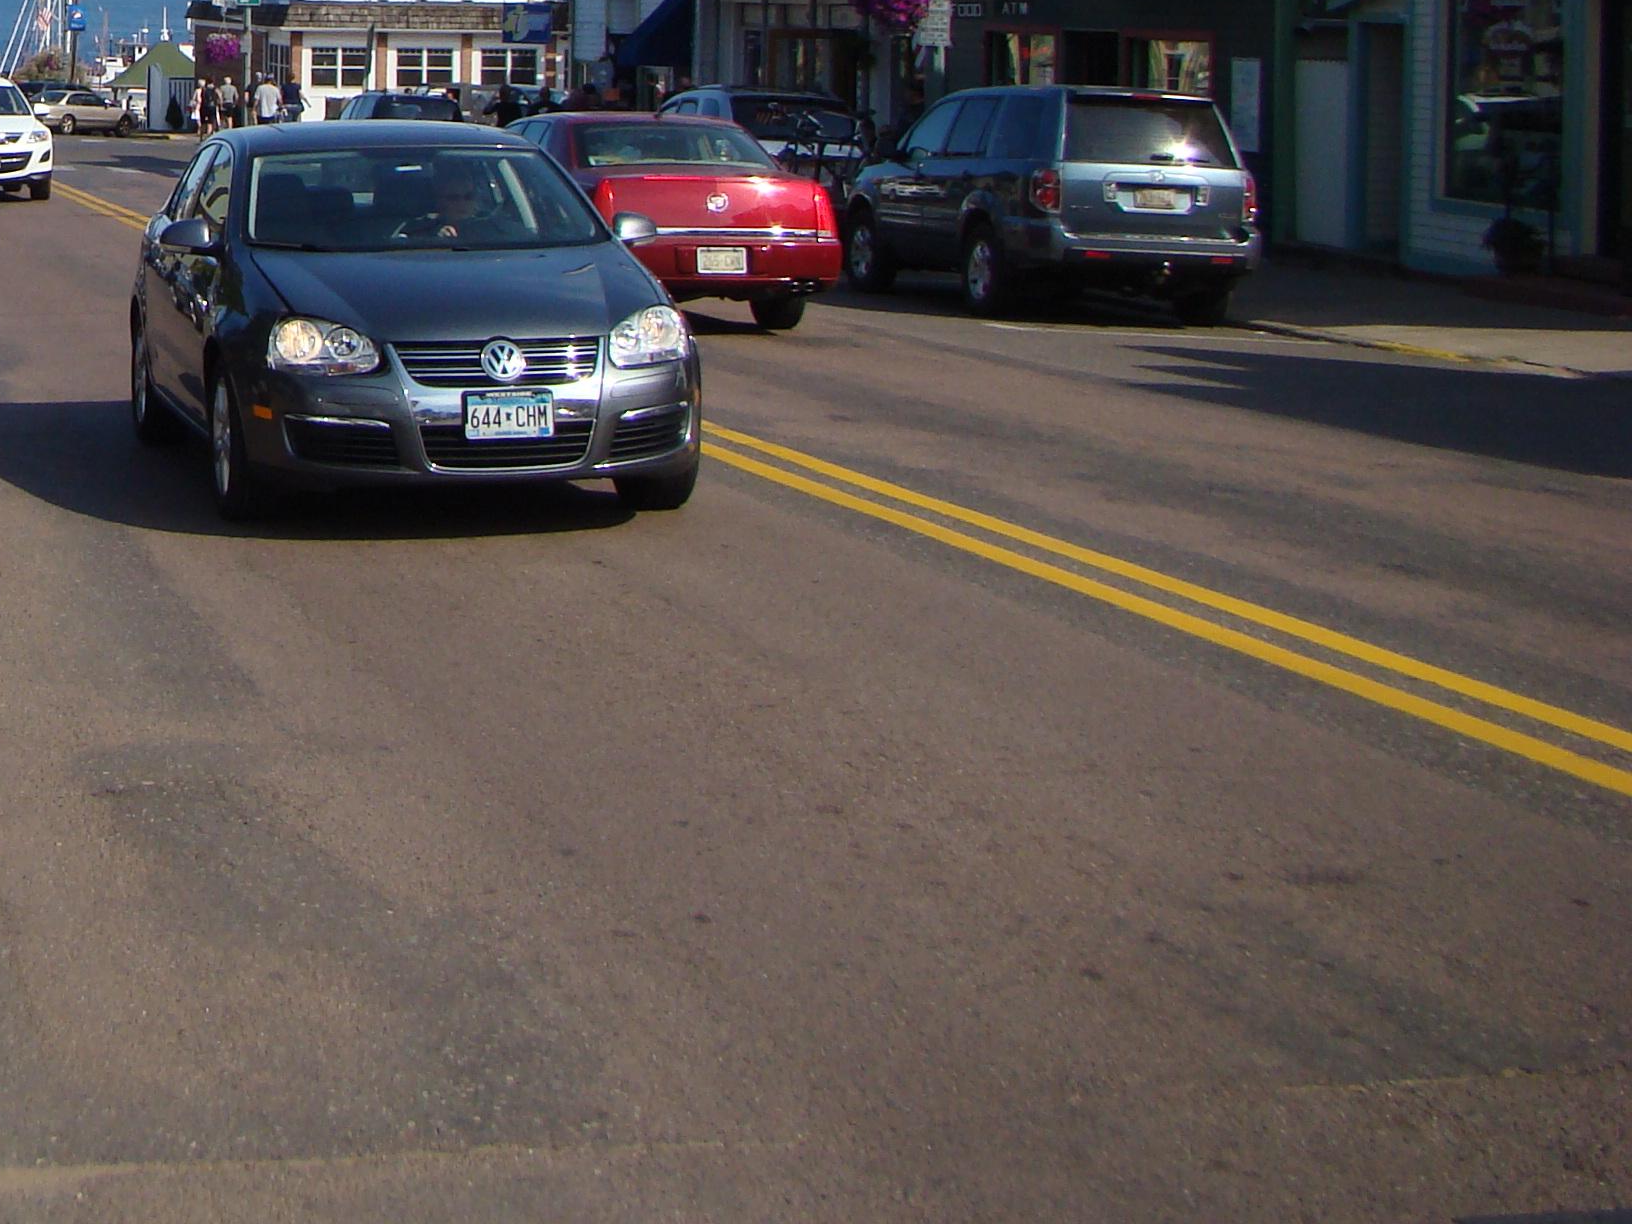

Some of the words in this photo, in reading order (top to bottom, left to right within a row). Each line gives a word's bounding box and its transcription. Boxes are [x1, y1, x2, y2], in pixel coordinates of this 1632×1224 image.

[1002, 2, 1028, 15] ATM
[471, 406, 502, 429] 644
[515, 405, 548, 427] CHM
